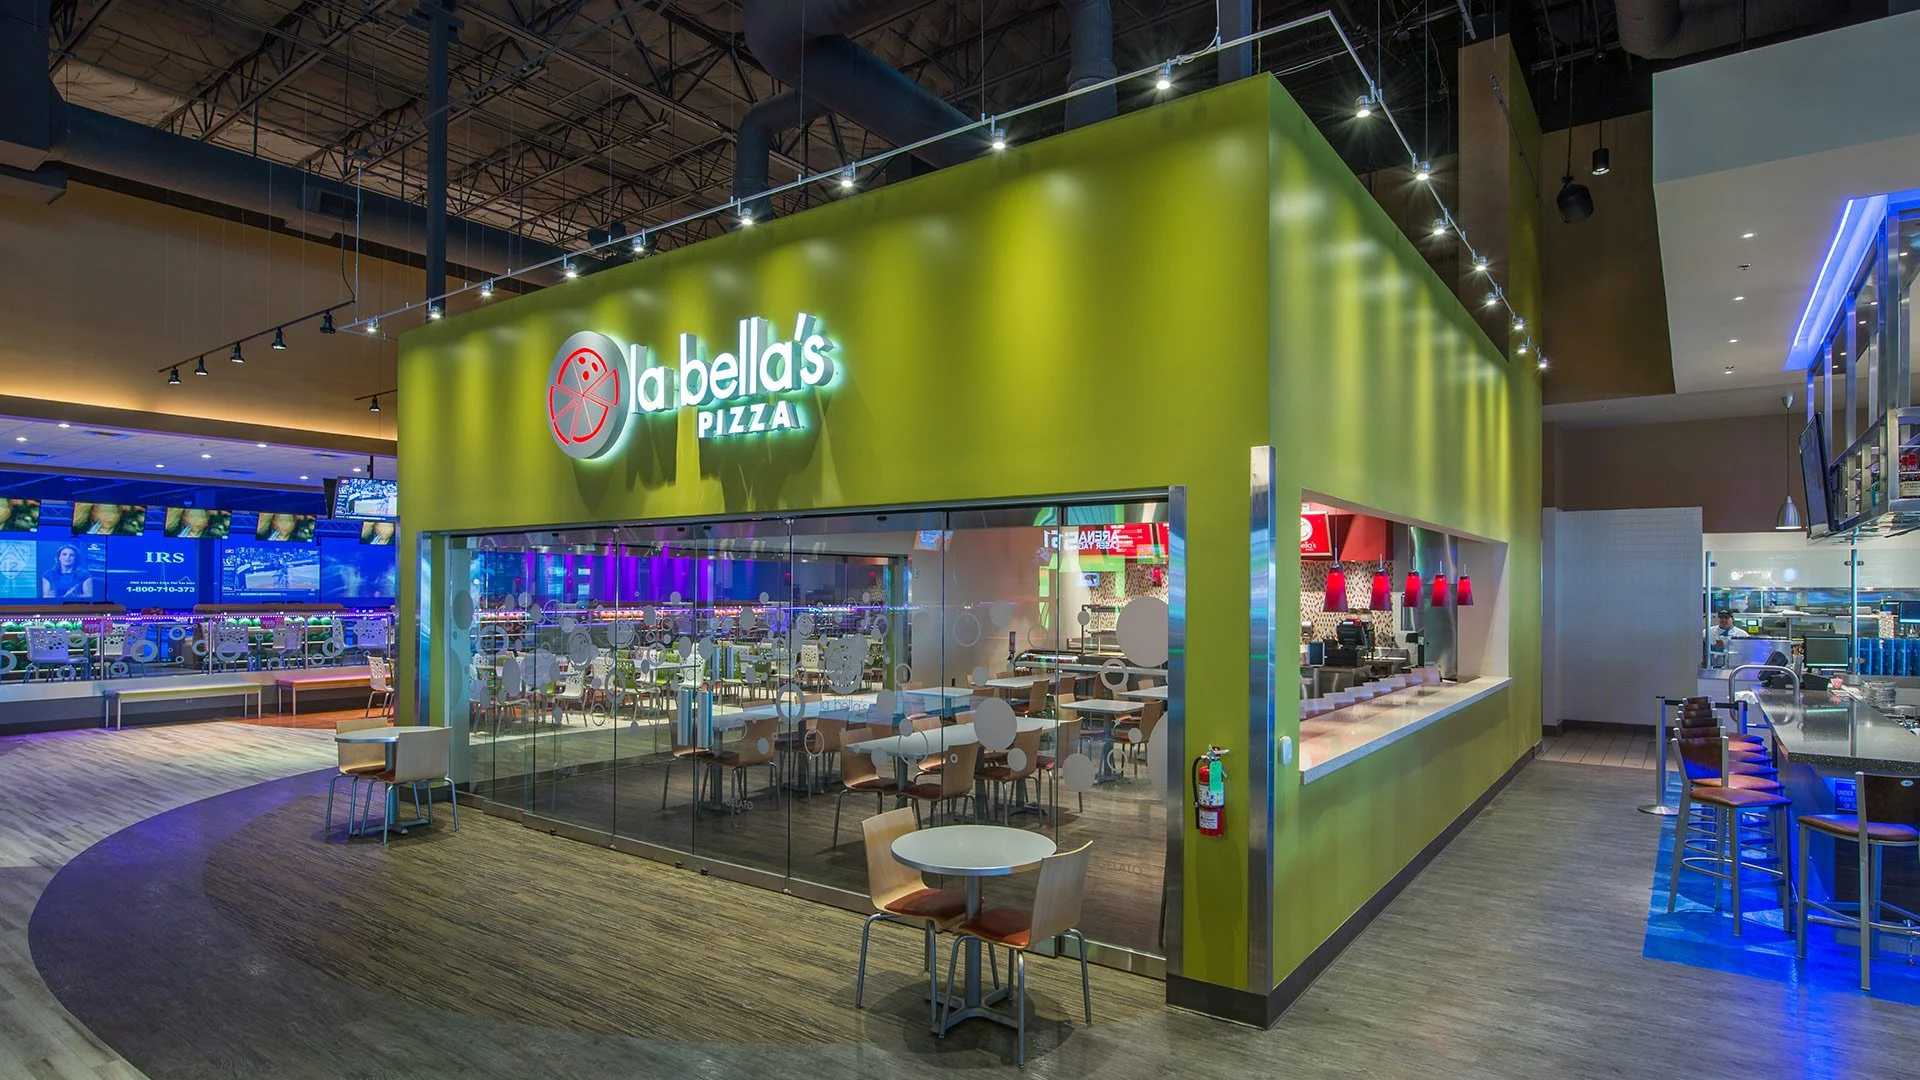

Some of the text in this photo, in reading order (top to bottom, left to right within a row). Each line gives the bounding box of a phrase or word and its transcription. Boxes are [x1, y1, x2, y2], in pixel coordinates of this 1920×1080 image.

[629, 313, 833, 413] la bella's
[698, 400, 798, 438] PIZZA
[145, 551, 184, 563] IRS
[726, 799, 754, 811] GELATO
